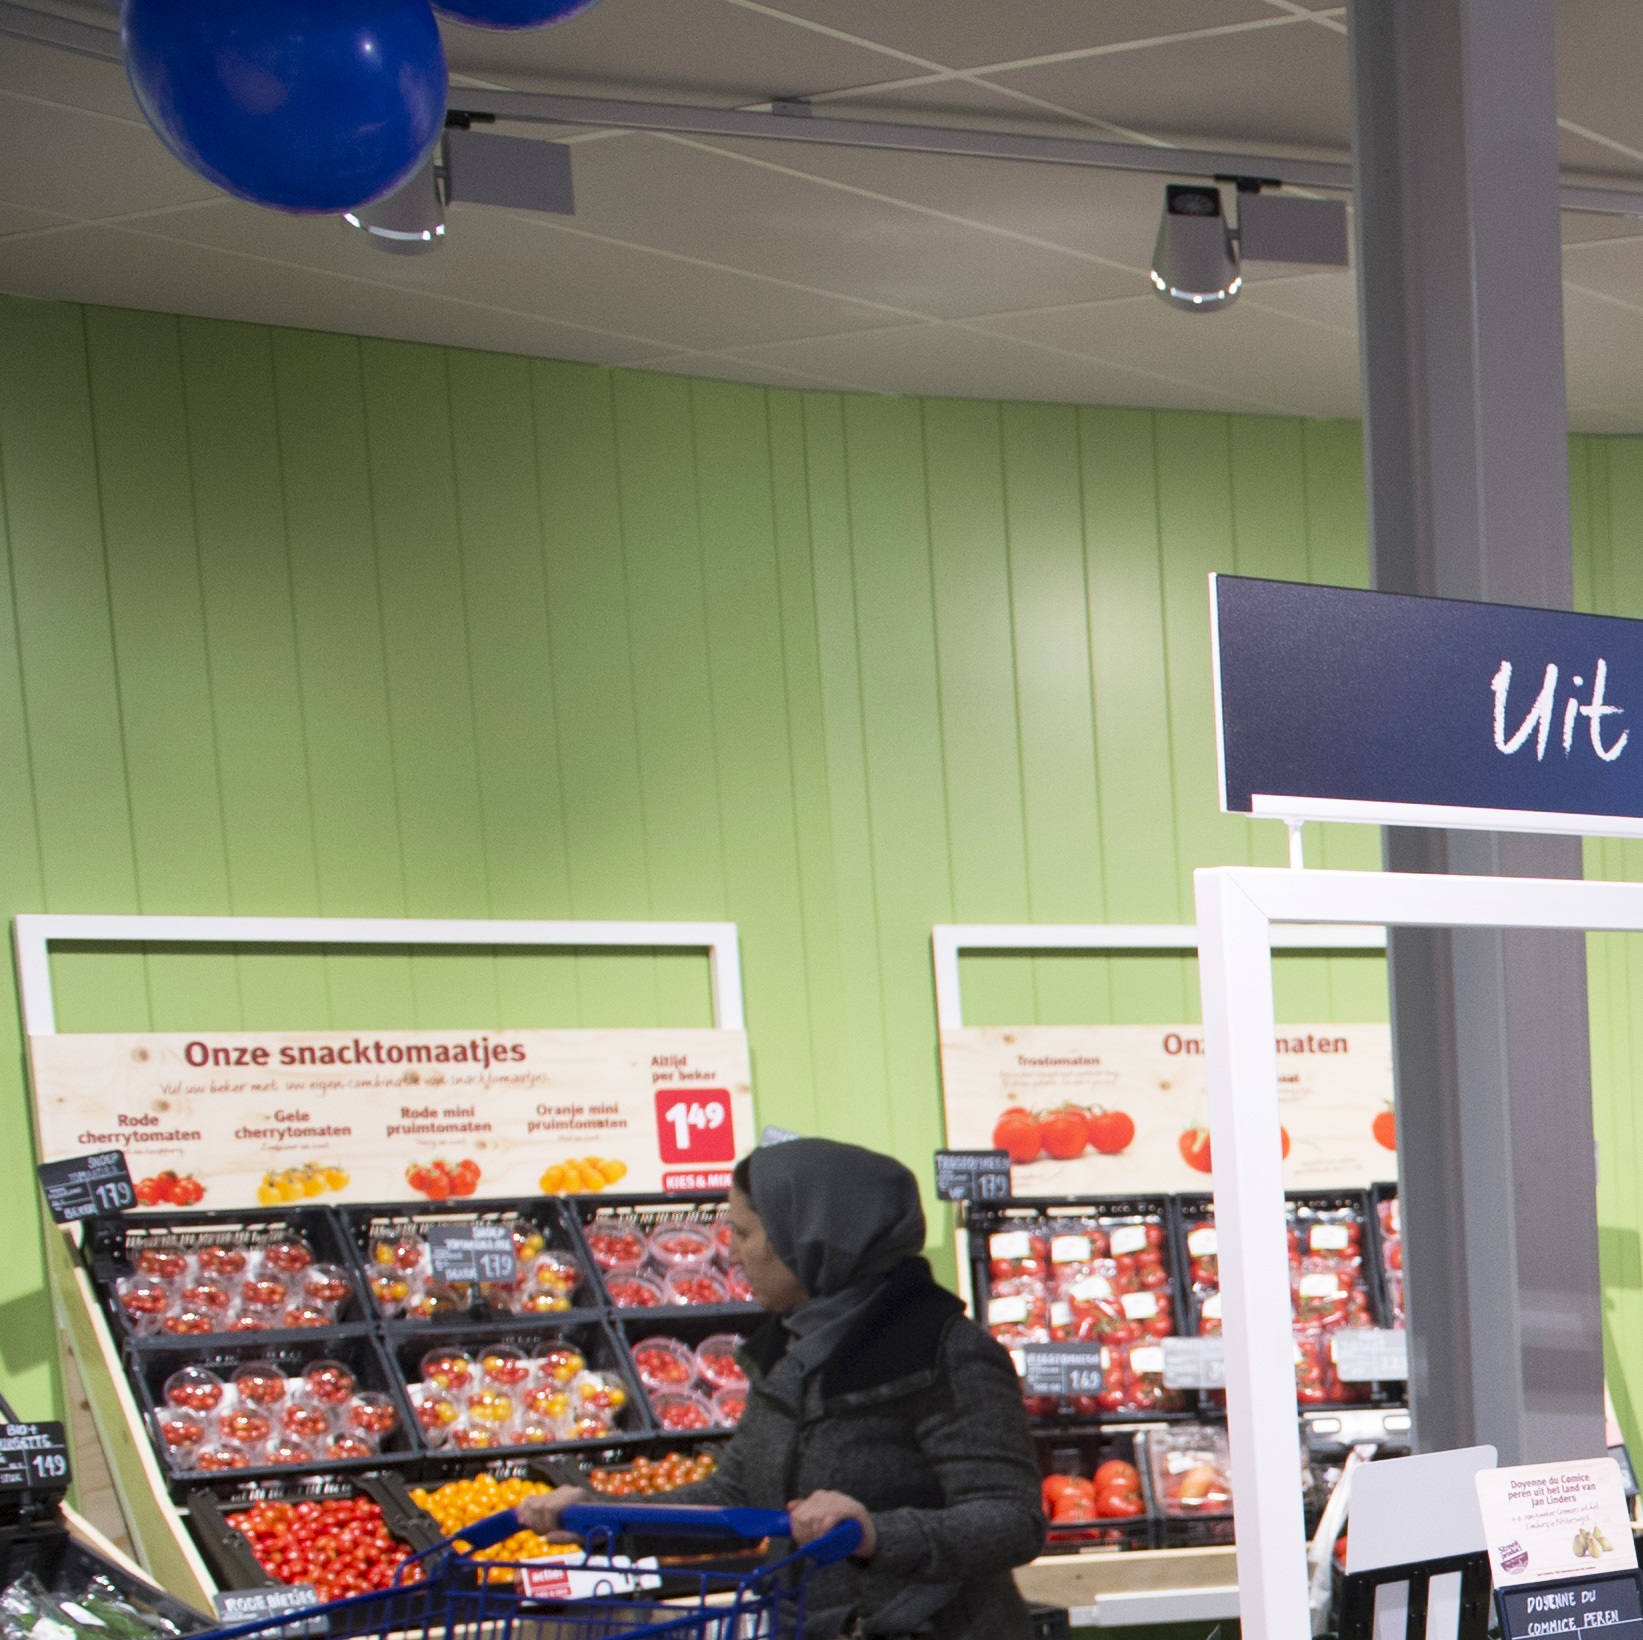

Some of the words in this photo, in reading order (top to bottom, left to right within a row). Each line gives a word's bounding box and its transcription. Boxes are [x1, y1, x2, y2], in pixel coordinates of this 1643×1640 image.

[1490, 659, 1628, 761] Uit
[184, 1040, 270, 1066] Onze
[279, 1037, 527, 1068] snacktomaatjes
[1018, 1055, 1101, 1066] Trostomaten
[651, 1055, 687, 1070] Altijd
[652, 1070, 675, 1083] per
[678, 1069, 716, 1081] beker
[274, 1110, 310, 1123] Gele
[401, 1106, 438, 1119] Rode
[443, 1105, 475, 1117] mini
[536, 1104, 584, 1119] Oranje
[589, 1103, 619, 1115] mini
[117, 1114, 159, 1127] Rode
[387, 1120, 492, 1137] pruimtomaten
[528, 1117, 628, 1133] pruimtomaten
[78, 1130, 201, 1146] cherrytomaten
[234, 1125, 352, 1141] cherrytomaten
[1511, 1478, 1547, 1490] Doyenne
[1549, 1477, 1559, 1485] du
[1561, 1473, 1590, 1484] Comice
[1508, 1489, 1532, 1501] peren
[1534, 1487, 1544, 1496] uit
[1547, 1485, 1560, 1495] het
[1562, 1483, 1580, 1493] land
[1582, 1482, 1597, 1491] van
[1531, 1497, 1545, 1508] Jan
[1546, 1494, 1577, 1505] Linders
[225, 1595, 264, 1614] RODE
[1527, 1592, 1577, 1613] DOYENNE
[1582, 1590, 1596, 1604] DU
[1528, 1617, 1577, 1636] COMMICE
[1584, 1610, 1619, 1628] PEREN
